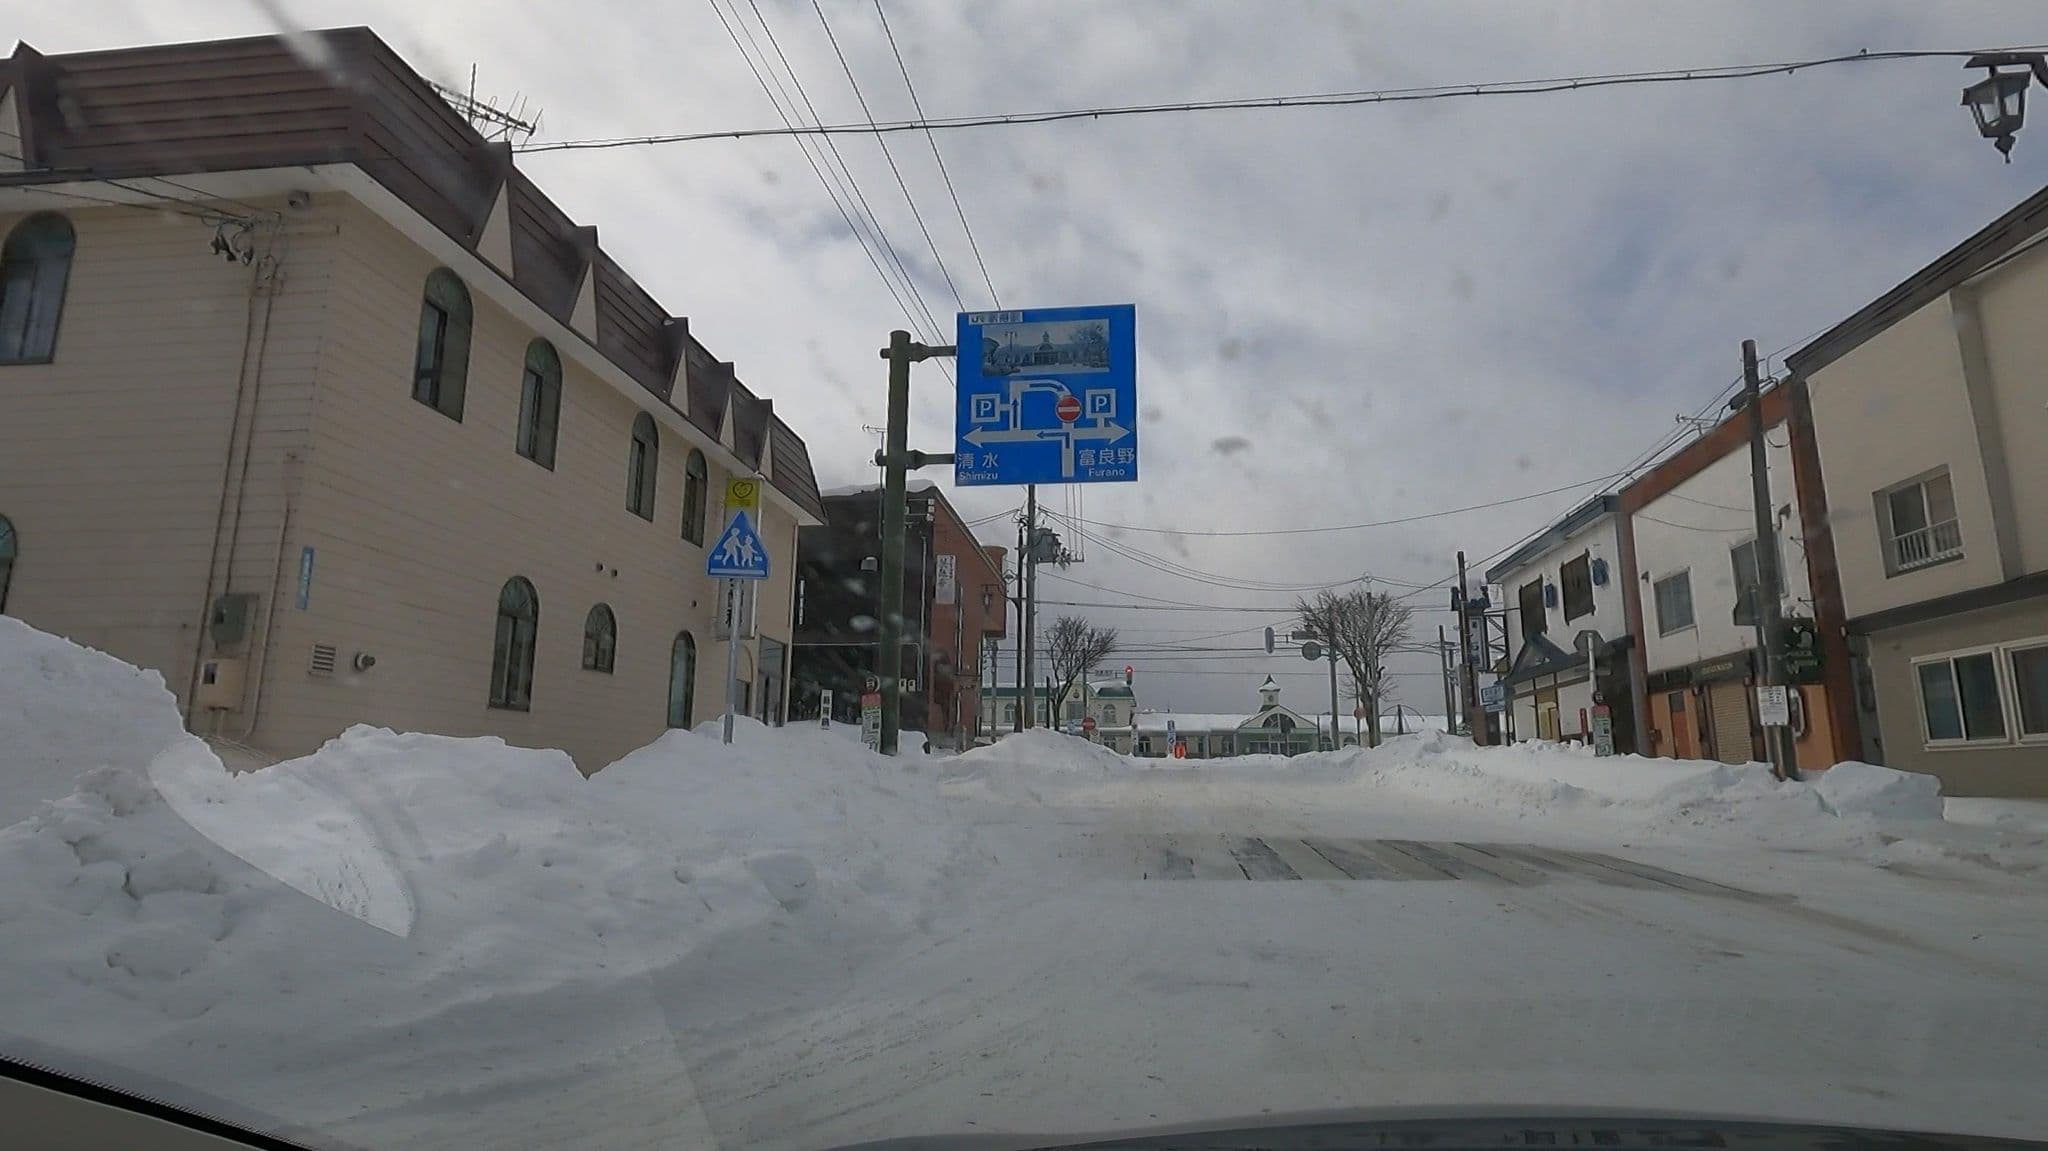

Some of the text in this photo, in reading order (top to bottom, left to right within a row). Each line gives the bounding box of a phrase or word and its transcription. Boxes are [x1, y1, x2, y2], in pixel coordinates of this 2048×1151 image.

[980, 400, 992, 416] P
[1096, 396, 1108, 412] P
[958, 453, 999, 470] 清水
[1079, 448, 1136, 466] 富良野
[959, 470, 999, 481] Shimizu
[1088, 468, 1126, 478] Furano
